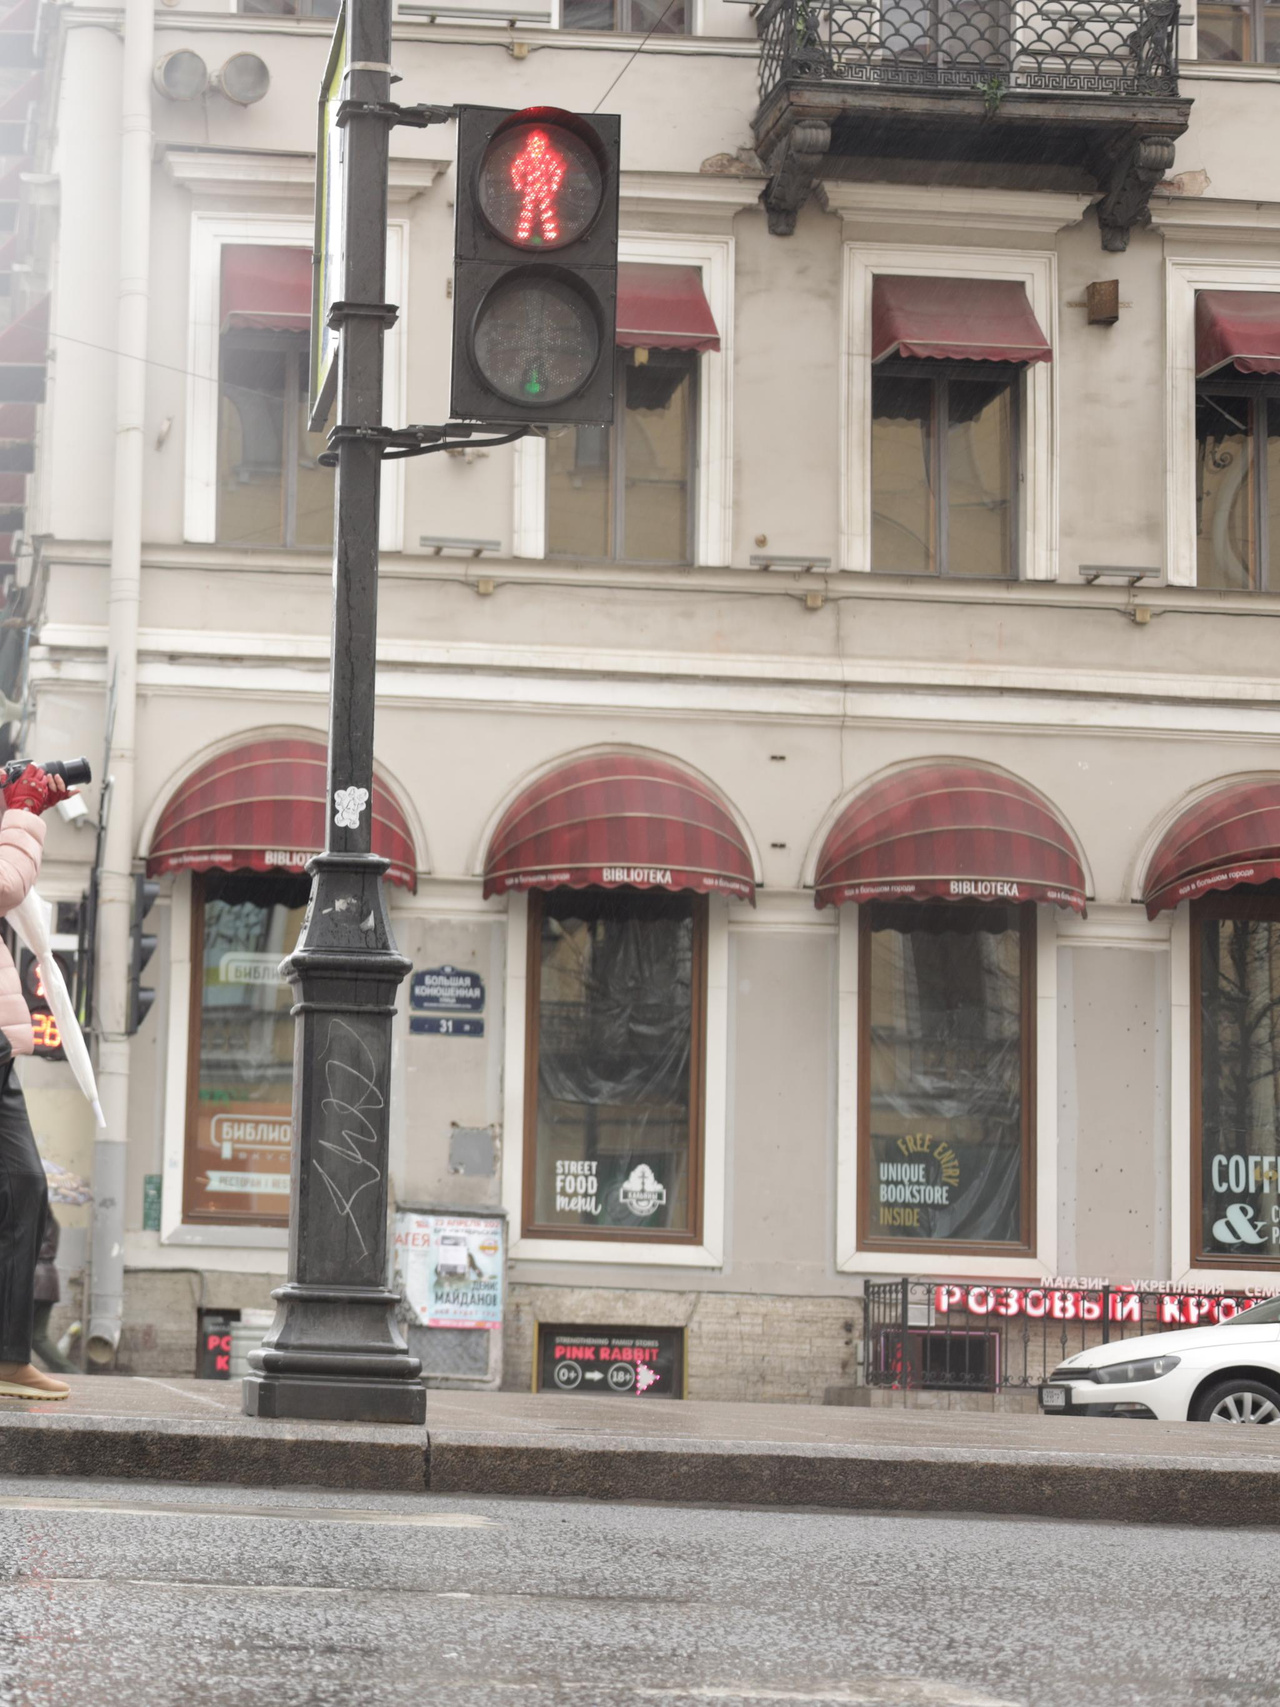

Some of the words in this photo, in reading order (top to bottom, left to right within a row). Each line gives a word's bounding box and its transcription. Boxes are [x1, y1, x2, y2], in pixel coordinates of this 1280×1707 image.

[264, 850, 318, 866] BIBLIOT
[602, 867, 672, 885] BIBLIOTEKA
[1197, 874, 1228, 887] большом
[1229, 869, 1254, 879] городе
[950, 880, 1019, 897] BIBLIOTEKA
[234, 965, 279, 980] БИБЛИ
[424, 974, 471, 988] БОЛЬШАЯ
[414, 985, 481, 999] КОНЮШЕННАЯ
[439, 1019, 453, 1033] 31
[222, 1121, 290, 1143] БИБЛИО
[556, 1160, 598, 1175] STREET
[897, 1133, 933, 1157] FREE
[933, 1141, 960, 1187] ENTRY
[880, 1162, 925, 1184] UNIQUE
[1212, 1154, 1280, 1193] COFF
[556, 1176, 598, 1195] FOOD
[879, 1184, 950, 1204] BOOKSTORE
[556, 1193, 602, 1216] menu
[879, 1206, 921, 1227] INSIDE
[1041, 1275, 1109, 1290] МАГАЗИН
[1131, 1279, 1224, 1296] УКРЕПЛЕНИЯ
[434, 1288, 497, 1308] МАЙДАНОВ
[935, 1284, 1141, 1323] РОЗОВЫЙ
[611, 1338, 634, 1346] FAMILY
[635, 1339, 659, 1347] STORES
[554, 1345, 596, 1360] PINK
[599, 1346, 660, 1361] RABBIT
[558, 1368, 577, 1381] 0+
[612, 1371, 632, 1383] 18+
